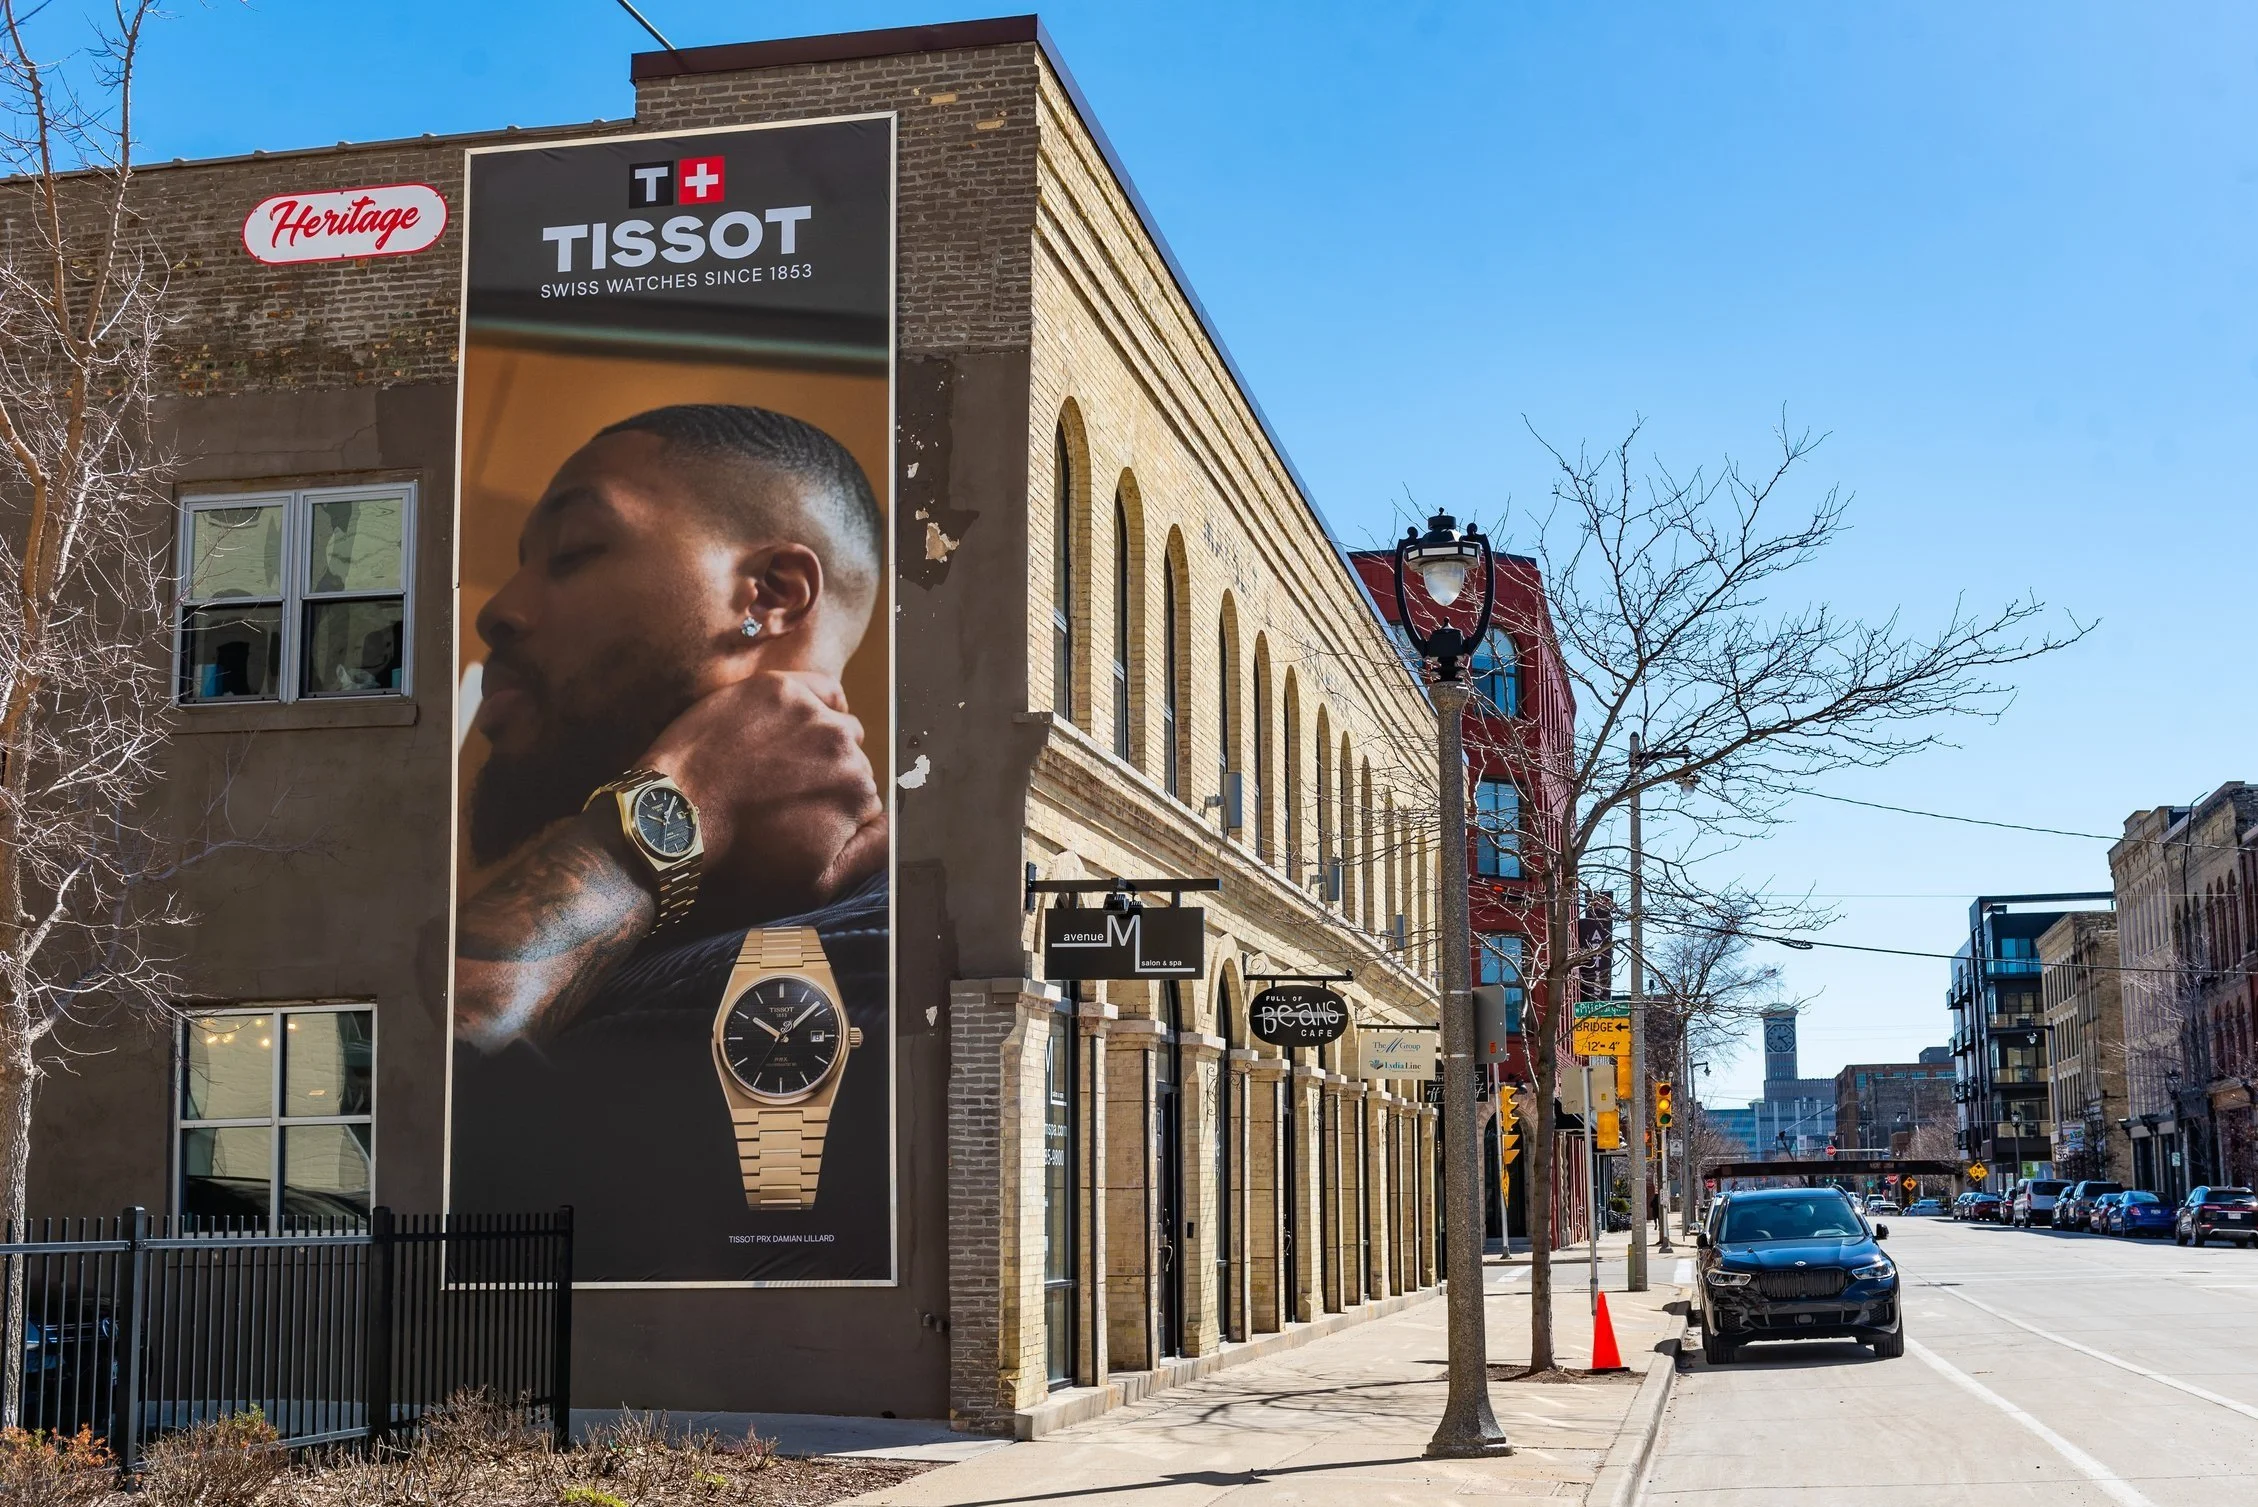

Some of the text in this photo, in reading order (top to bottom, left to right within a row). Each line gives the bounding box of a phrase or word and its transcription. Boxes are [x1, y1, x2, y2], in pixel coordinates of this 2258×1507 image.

[269, 196, 422, 250] Heritage
[542, 205, 812, 273] TISSOT
[541, 263, 812, 299] SWISS WATCHES SINCE 1853
[1063, 914, 1141, 953] avenue M
[1141, 959, 1161, 967] salon
[1576, 1022, 1614, 1032] BRIDGE
[1300, 1029, 1333, 1037] CAFE
[1372, 1041, 1386, 1049] The
[1399, 1042, 1421, 1050] Group
[1385, 1061, 1405, 1070] Lydia
[728, 1234, 835, 1243] TISSOT PRX DAMIAN LILLARD
